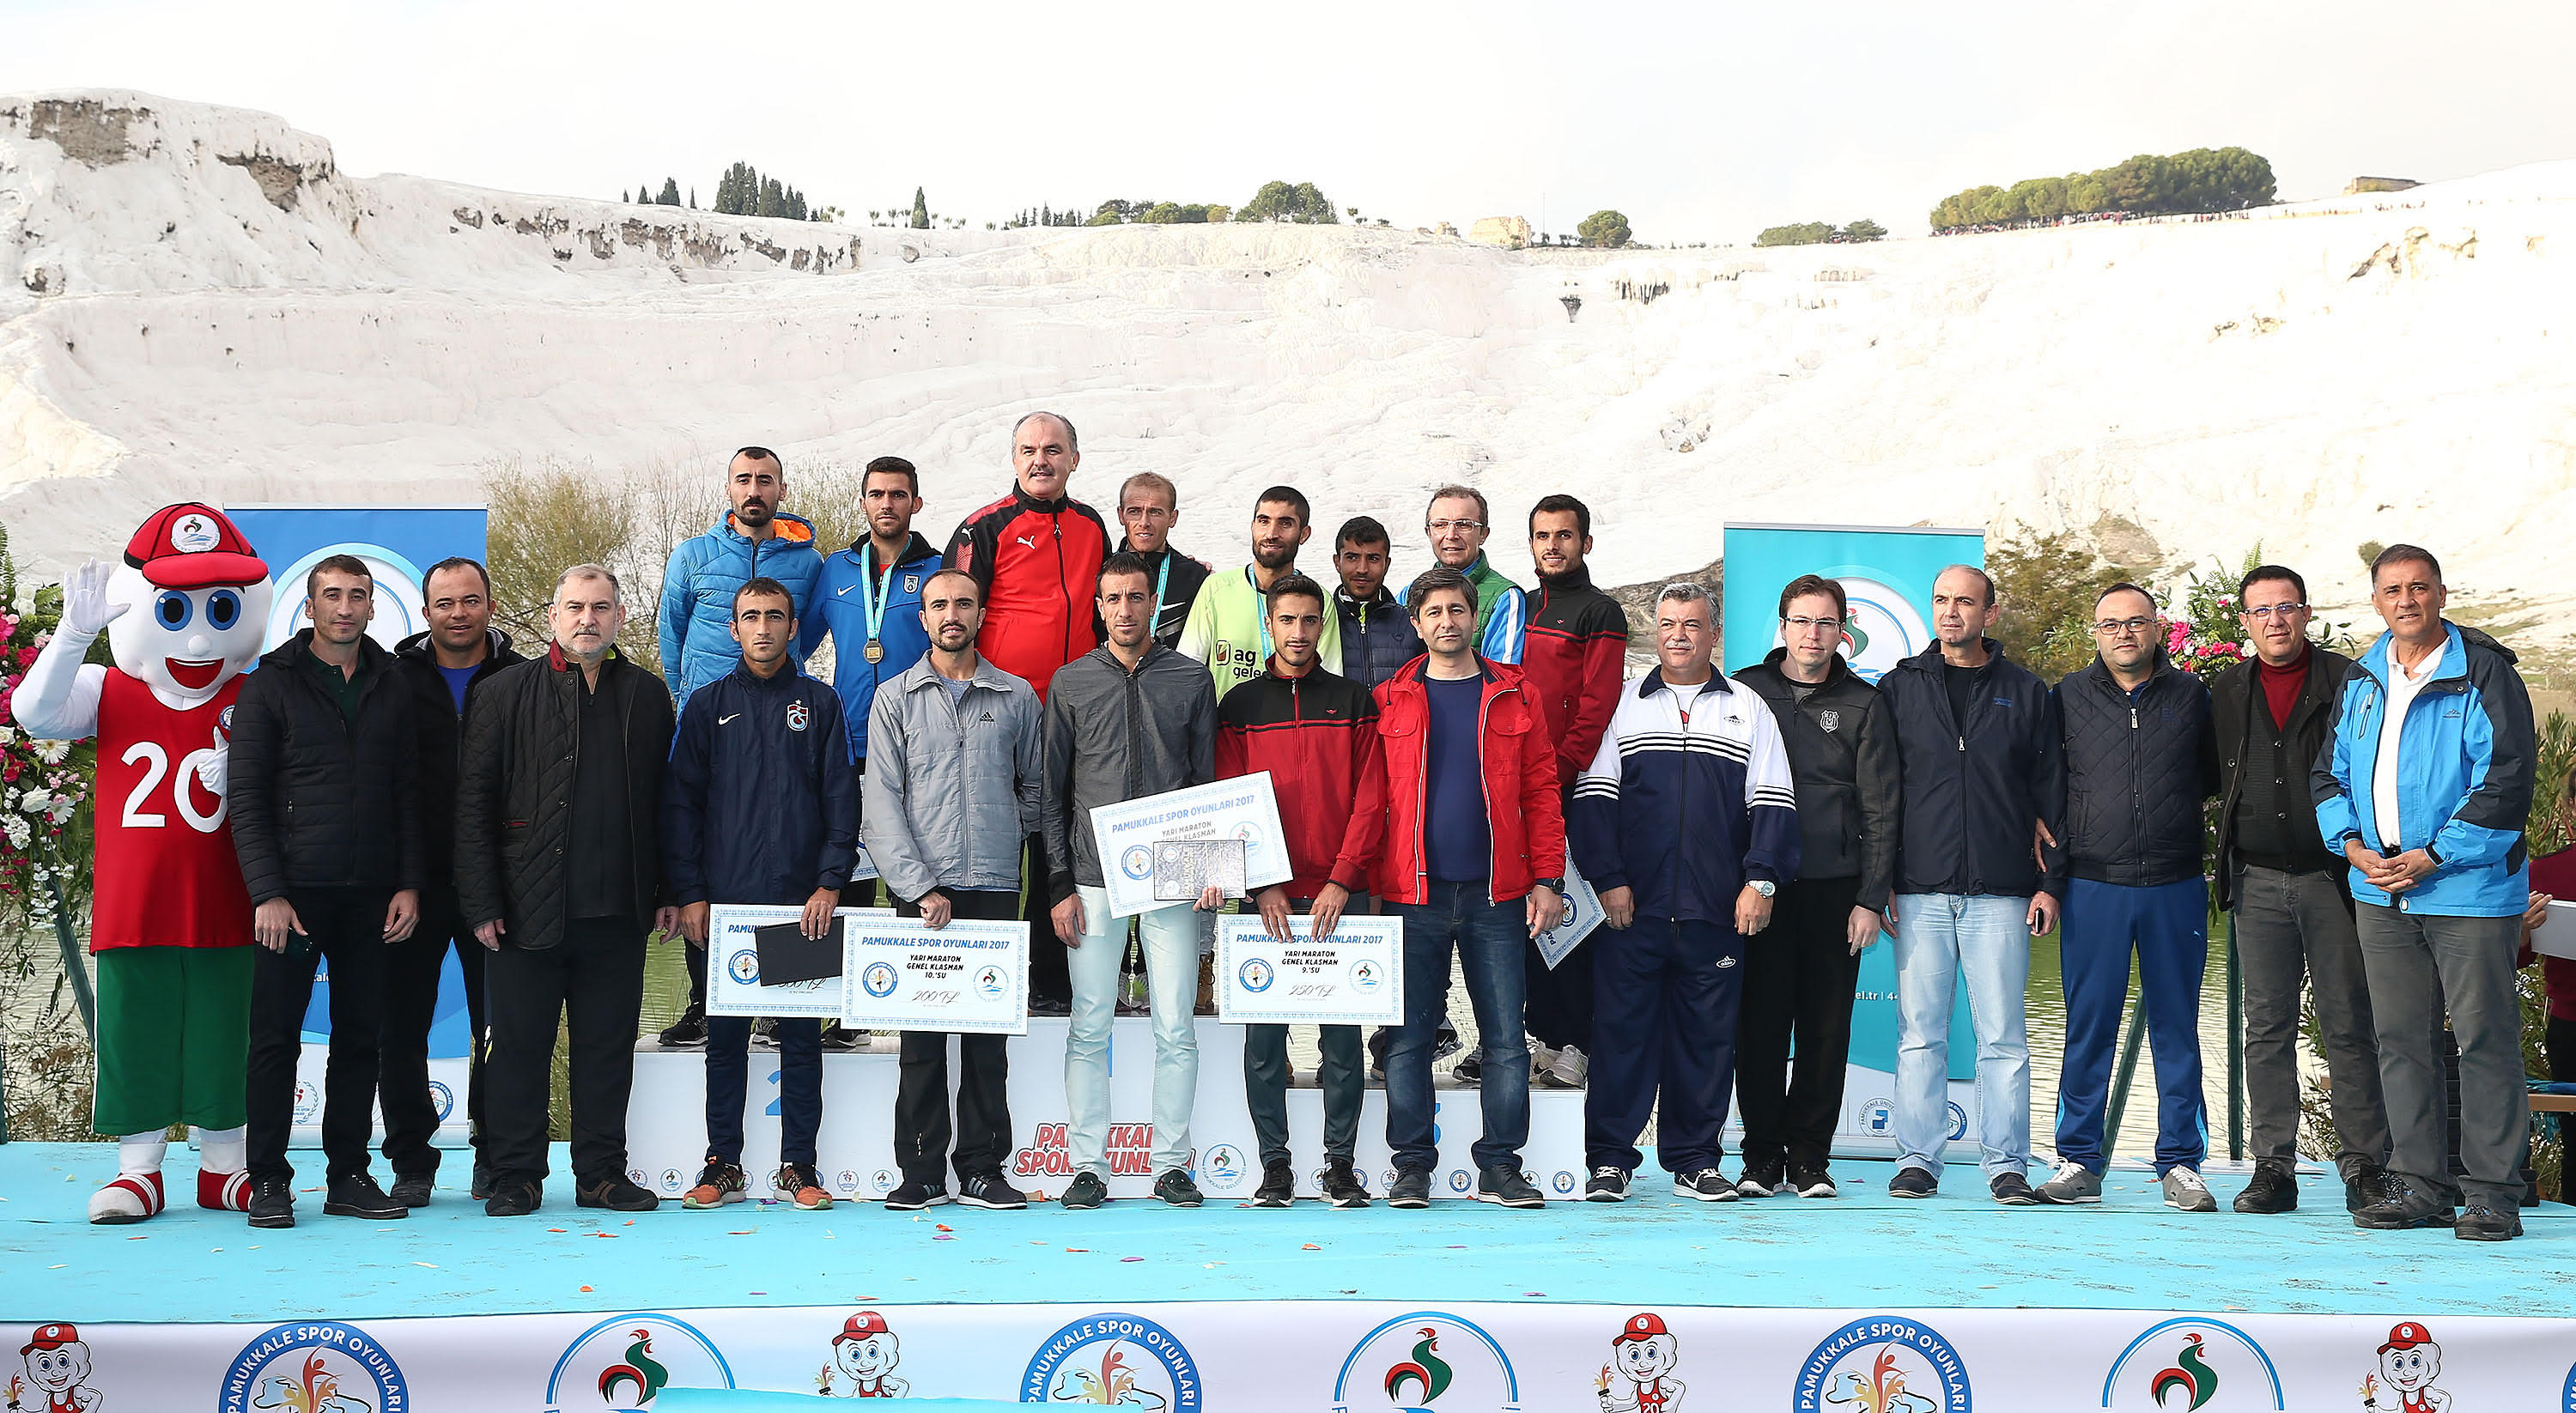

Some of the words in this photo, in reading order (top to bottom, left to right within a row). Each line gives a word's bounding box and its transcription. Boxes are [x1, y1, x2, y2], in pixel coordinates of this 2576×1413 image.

[1112, 814, 1164, 834] PAMUKKALE
[1165, 808, 1189, 822] SPOR
[1191, 800, 1234, 816] OYUNLARI
[1236, 795, 1255, 809] 2017
[1162, 828, 1177, 837] YARI
[1179, 821, 1212, 834] MARATON
[861, 937, 916, 947] PAMUKKALE
[917, 938, 941, 948] SPOR
[944, 939, 988, 949] OYUNLARI
[989, 940, 1010, 949] 2017
[1363, 935, 1383, 944] 2017
[226, 1330, 294, 1413] PAMUKKALE
[297, 1326, 346, 1345] SPOR
[348, 1337, 402, 1413] OYUNLARI
[1097, 1319, 1145, 1338] SPOR
[1146, 1331, 1195, 1407] OYUNLARI
[1801, 1326, 1868, 1410] PAMUKKALE
[1870, 1323, 1917, 1342] SPOR
[1918, 1334, 1965, 1411] OYUNLARI
